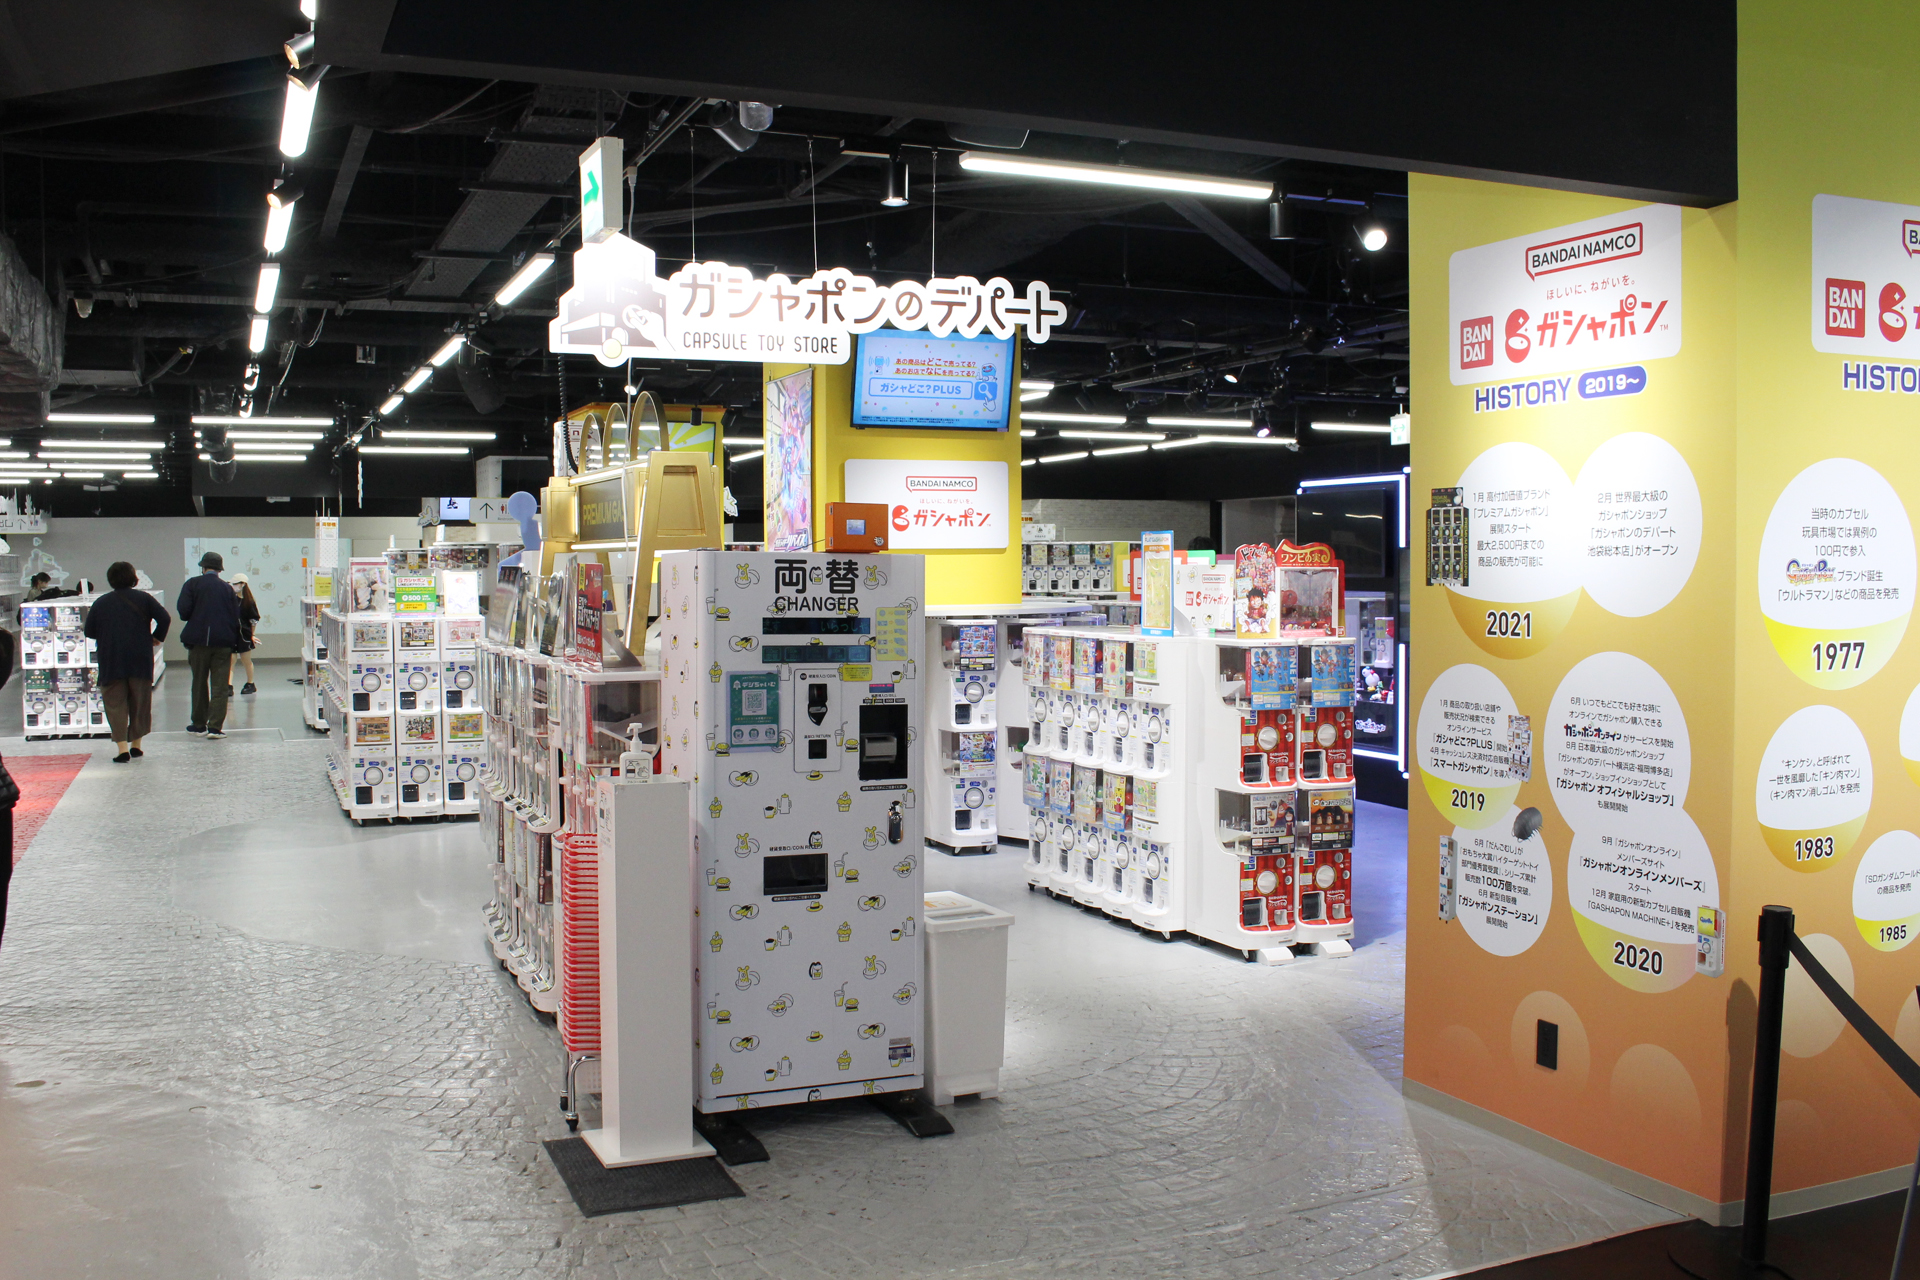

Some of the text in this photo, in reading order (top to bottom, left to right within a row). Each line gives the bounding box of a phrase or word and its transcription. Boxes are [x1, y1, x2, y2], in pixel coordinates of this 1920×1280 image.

[1532, 233, 1636, 268] BANDAI NAMCO
[1546, 275, 1636, 300] ほしいに、ねがいを。
[679, 275, 1060, 334] ガシャポンのデパート
[1829, 287, 1863, 309] BAN
[1537, 294, 1669, 348] ガシャポン
[1829, 308, 1856, 329] DAI
[1464, 324, 1491, 344] BAN
[683, 332, 839, 354] CAPSULE TOY STORE
[1464, 342, 1486, 363] DAI
[1843, 363, 1920, 393] HISTO
[880, 383, 962, 395] ガシャどこ?PLUS
[1475, 378, 1571, 412] HISTORY
[910, 480, 974, 488] BANDAI NAMCO
[1597, 490, 1668, 504] 2月 世界最大級の
[913, 508, 991, 527] ガシャポン
[1598, 508, 1668, 521] ガシャポンショップ
[1811, 508, 1869, 520] 当時のカプセル
[1489, 523, 1531, 535] 展開スタート
[1590, 526, 1676, 539] 「ガシャポンのデパート
[1802, 526, 1877, 539] 玩具市場では異例の
[1587, 544, 1679, 557] 池袋総本店」がオープン
[1814, 544, 1866, 557] 100円で参入
[1478, 556, 1543, 567] 商品の販売が可能に
[774, 559, 859, 594] 両替
[1838, 570, 1884, 582] ブランド誕生
[1778, 588, 1899, 602] 「ウルトラマン」などの商品を発売
[775, 596, 859, 612] CHANGER
[1486, 611, 1531, 638] 2021
[1813, 642, 1865, 671] 1977
[1570, 697, 1661, 713] 6月 いつでもどこでも好きな時に
[1568, 711, 1663, 728] オンラインでガシャポン購入できる
[1446, 724, 1492, 736] オンラインサービス
[1623, 734, 1674, 749] がサービスを開始
[1578, 743, 1665, 761] 日本最大級のガシャポンショップ
[1451, 788, 1485, 812] 2019
[1556, 777, 1674, 807] 「ガシャポン オフィシャルショップ」
[1474, 838, 1484, 848] 6月
[1601, 836, 1613, 846] 9月
[1795, 837, 1834, 860] 1983
[1616, 853, 1665, 869] メンバーズサイト
[1478, 888, 1488, 899] 6月
[1591, 888, 1607, 900] 12月
[1627, 882, 1652, 895] スタート
[1877, 883, 1912, 895] の商品を発売
[1879, 925, 1907, 942] 1985
[1614, 941, 1663, 975] 2020
